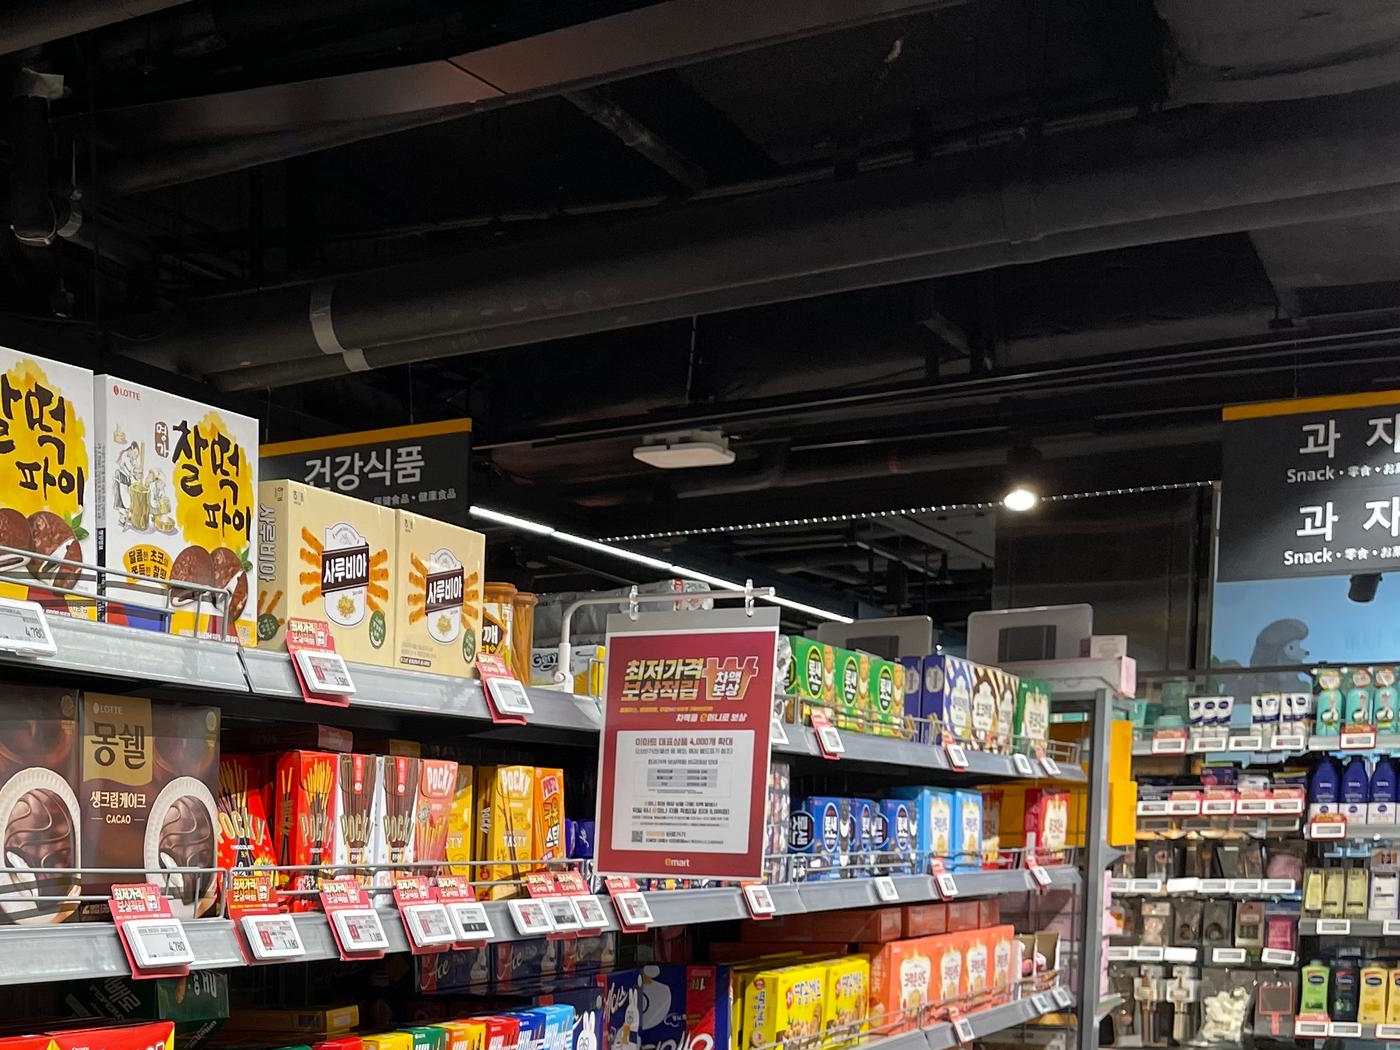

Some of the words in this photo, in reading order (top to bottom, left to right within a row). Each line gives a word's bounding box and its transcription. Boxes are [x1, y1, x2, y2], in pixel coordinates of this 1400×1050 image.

[120, 389, 141, 401] LOTTE
[172, 420, 241, 505] 찰떡
[304, 445, 425, 491] 건강식품
[15, 457, 85, 506] 파이
[1287, 465, 1335, 484] Snack
[202, 502, 252, 542] 파이
[1284, 547, 1333, 566] Snack
[323, 553, 368, 583] 사루비아
[427, 575, 464, 605] 사루비아
[625, 658, 704, 682] 최저가격
[716, 671, 742, 684] 차액
[621, 681, 699, 702] 보상적립
[712, 684, 740, 697] 보상
[100, 704, 123, 715] LOTTE
[91, 721, 146, 770] 몽쉘
[90, 790, 146, 809] 생크림케이크
[106, 814, 131, 825] CACAO
[664, 858, 691, 868] emart
